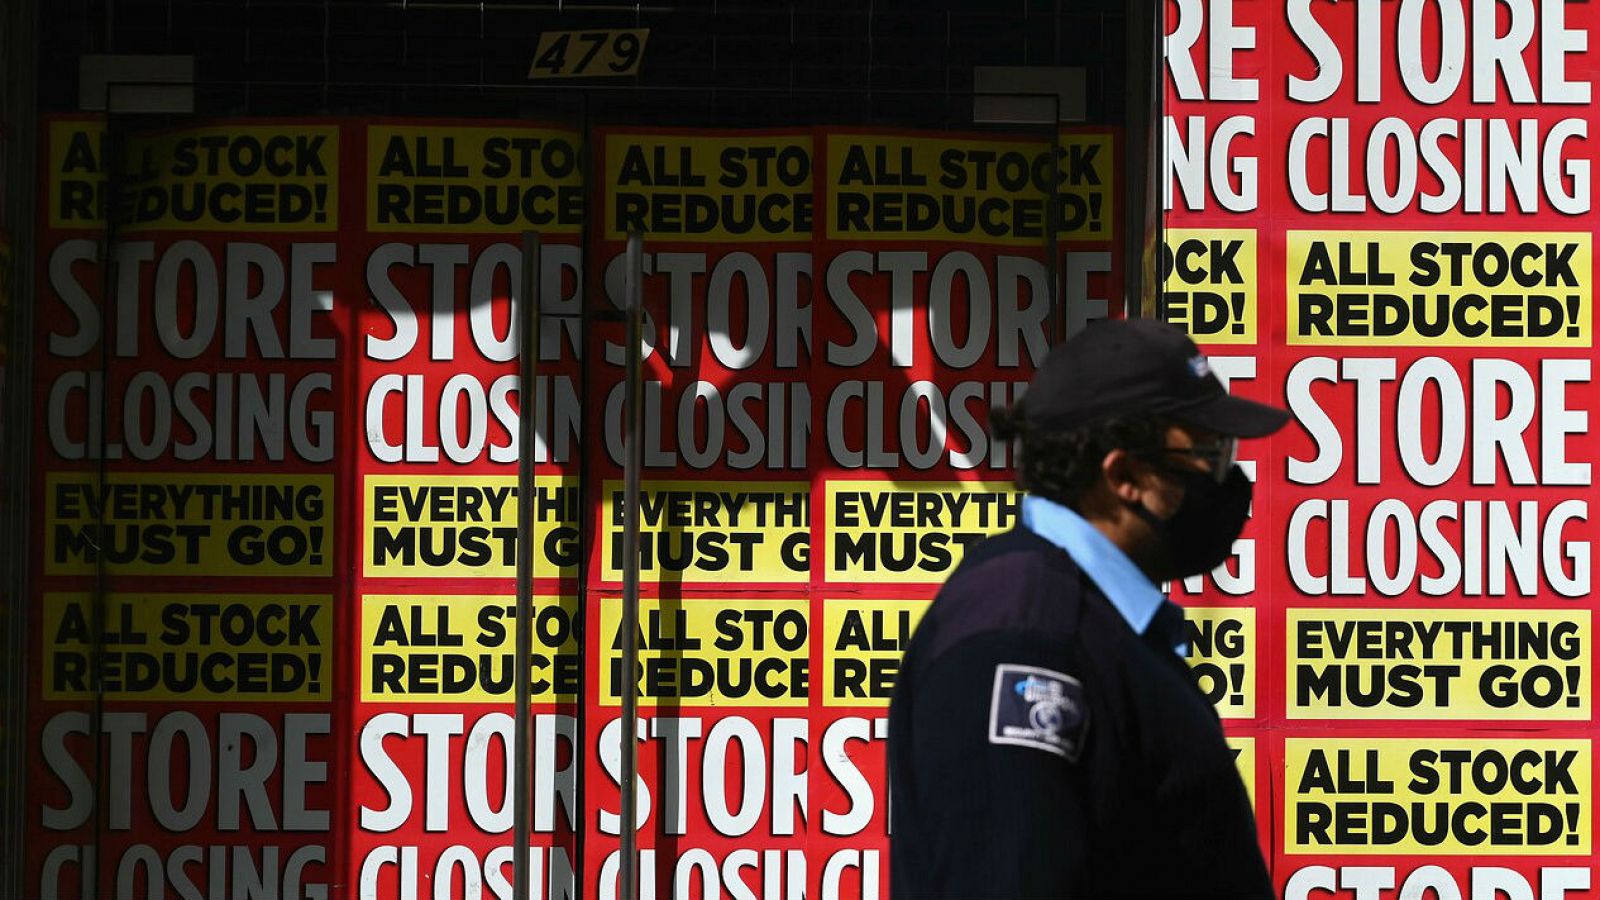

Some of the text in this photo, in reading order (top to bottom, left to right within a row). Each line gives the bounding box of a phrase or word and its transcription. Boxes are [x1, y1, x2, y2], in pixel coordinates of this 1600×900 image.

[534, 33, 640, 74] 479
[1287, 0, 1592, 103] STORE
[171, 136, 327, 176] STOCK
[379, 136, 582, 178] ALL STO
[616, 145, 706, 187] ALL
[838, 143, 1101, 192] ALL STOCK
[1288, 117, 1591, 214] CLOSING
[60, 180, 328, 223] REDUCED!
[837, 192, 1102, 238] REDUCED!
[1298, 242, 1580, 288] ALL STOCK
[49, 239, 337, 359] STORE
[1298, 294, 1581, 338] REDUCED!
[49, 370, 335, 462] CLOSING
[1286, 356, 1592, 487] STORE
[55, 484, 323, 522] EVERYTHING
[54, 524, 323, 566] MUST GO!
[373, 527, 519, 566] MUST
[610, 531, 763, 571] MUST
[1287, 499, 1591, 597] CLOSING
[55, 602, 321, 645] ALL STOCK
[373, 605, 463, 646] ALL
[1296, 621, 1581, 660] EVERYTHING
[53, 651, 321, 693] REDUCED!
[1296, 664, 1581, 708] MUST GO!
[41, 710, 331, 832] STORE
[1297, 749, 1579, 796] ALL STOCK
[1296, 802, 1580, 846] REDUCED!
